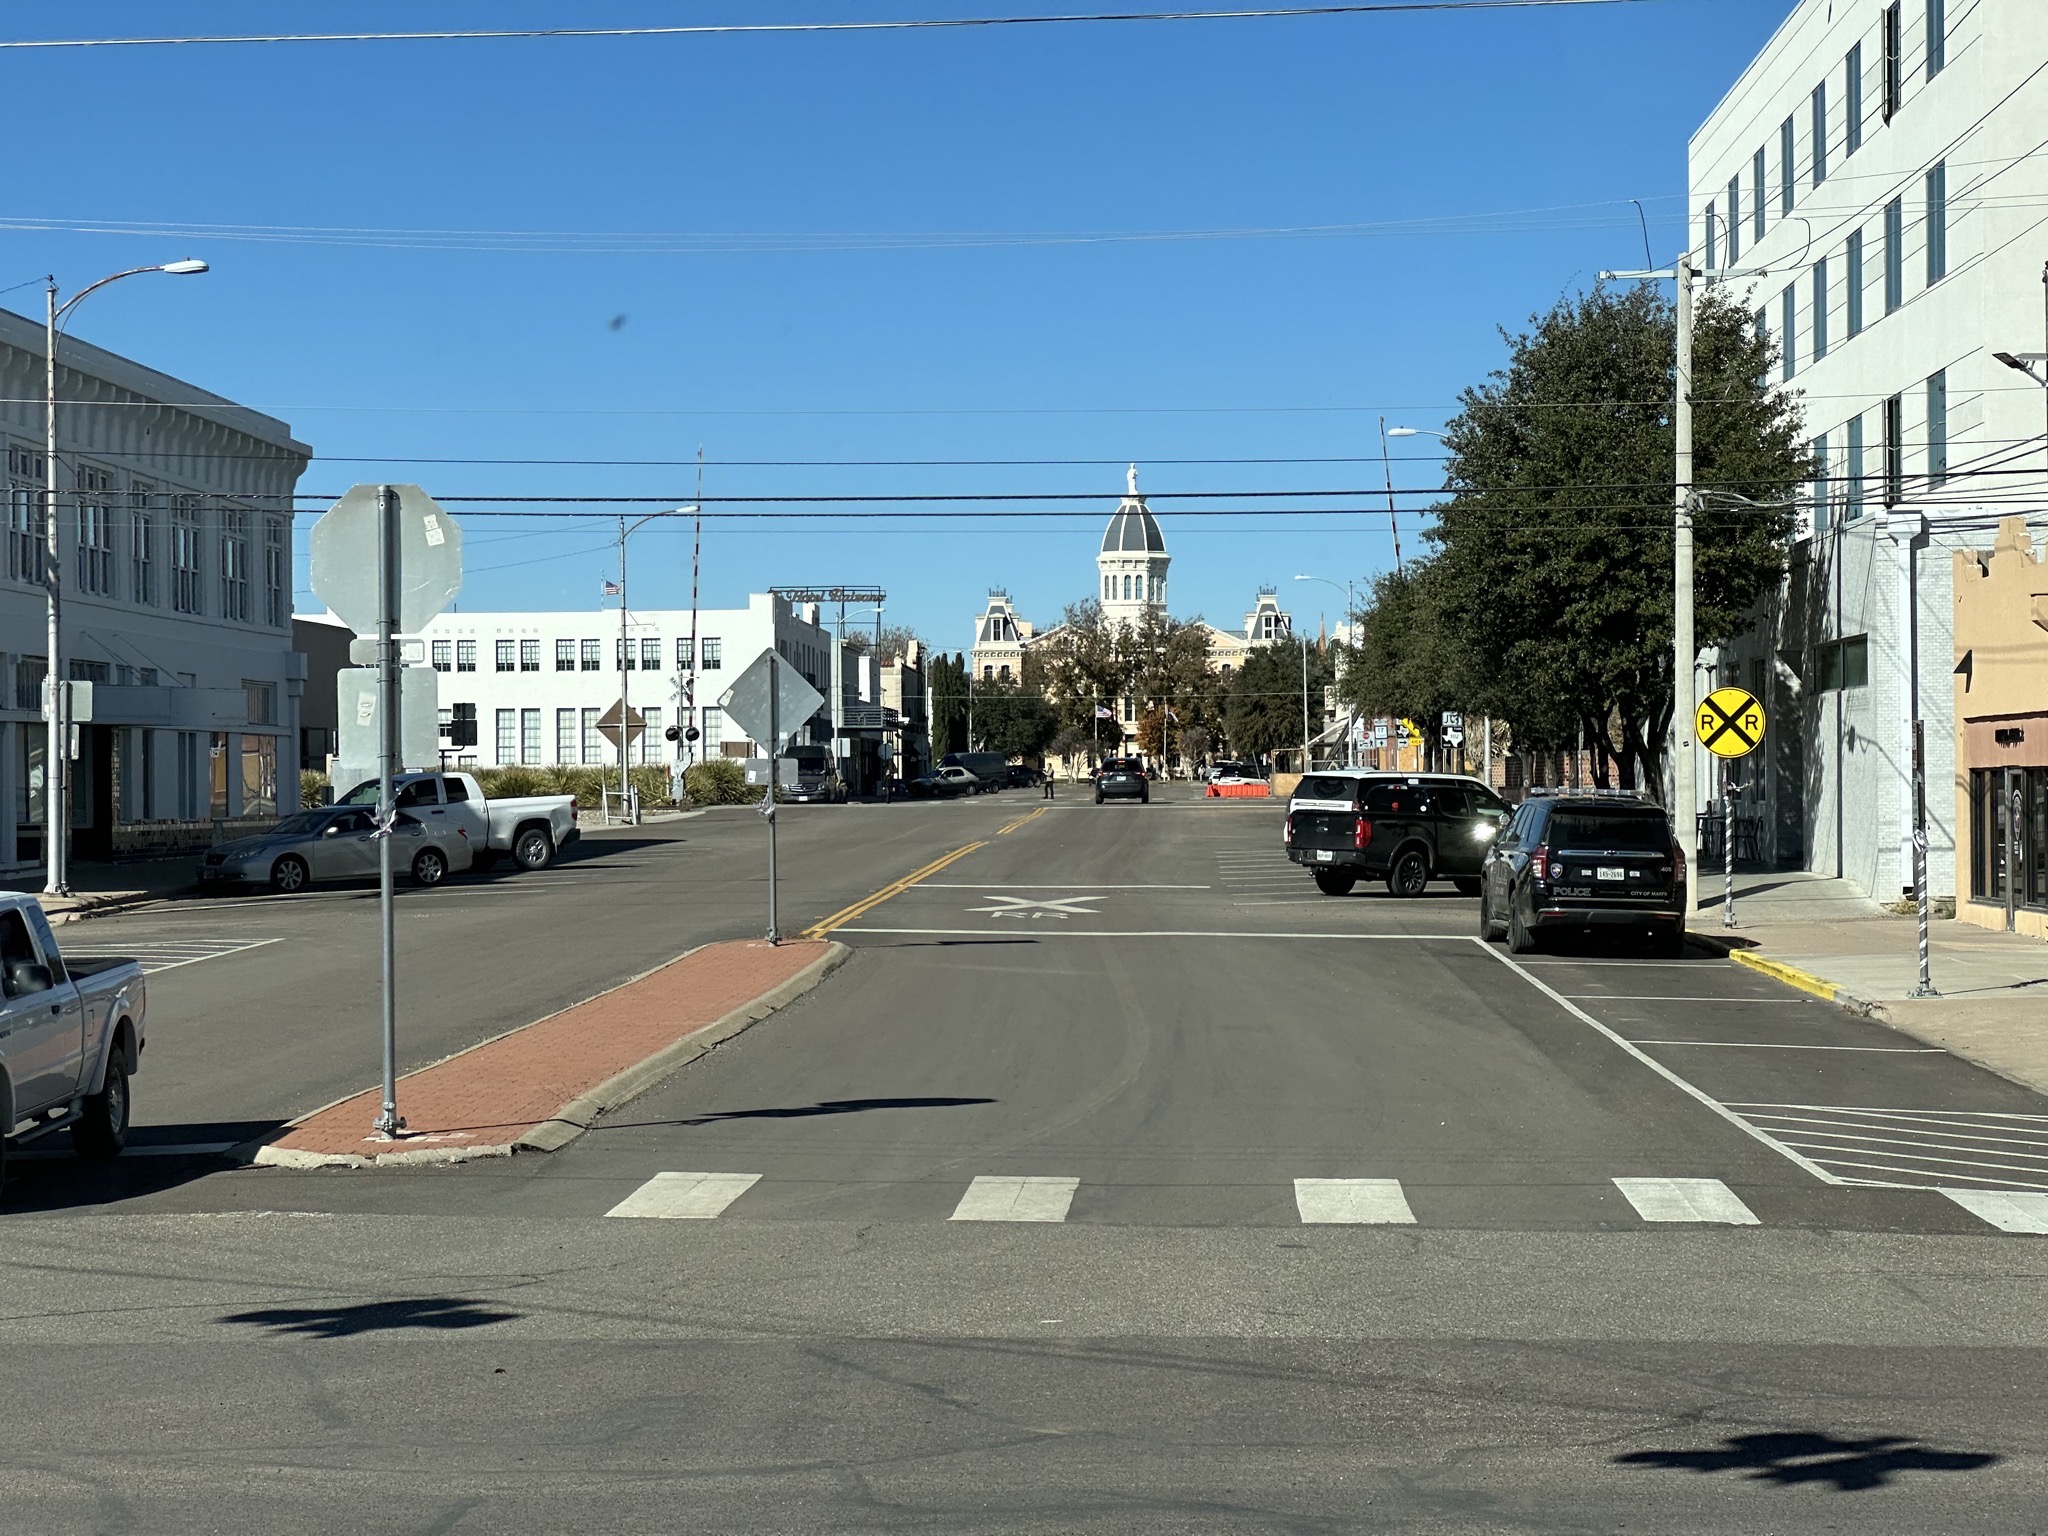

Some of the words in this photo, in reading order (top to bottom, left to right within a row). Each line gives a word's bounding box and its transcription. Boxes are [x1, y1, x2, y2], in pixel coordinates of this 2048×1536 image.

[786, 589, 825, 602] Hotel
[1701, 714, 1714, 730] R
[1745, 714, 1758, 730] R
[1553, 887, 1591, 896] POLICE
